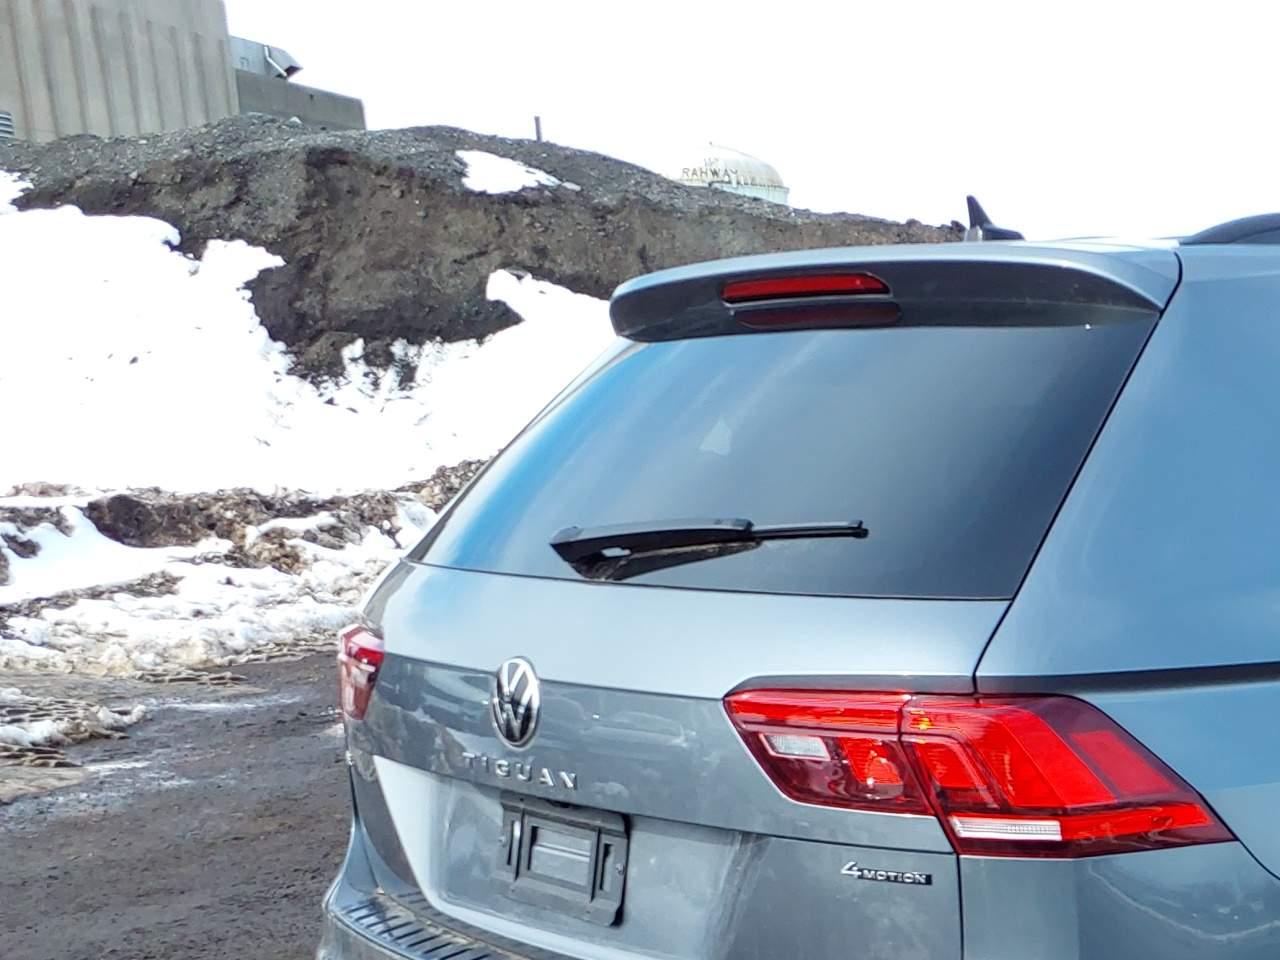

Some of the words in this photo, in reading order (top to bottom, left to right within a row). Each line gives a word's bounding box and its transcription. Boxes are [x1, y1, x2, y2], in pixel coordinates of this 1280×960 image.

[682, 167, 738, 181] RAHWAY
[462, 751, 577, 790] TIGUAN
[840, 861, 928, 884] 4MOTION
